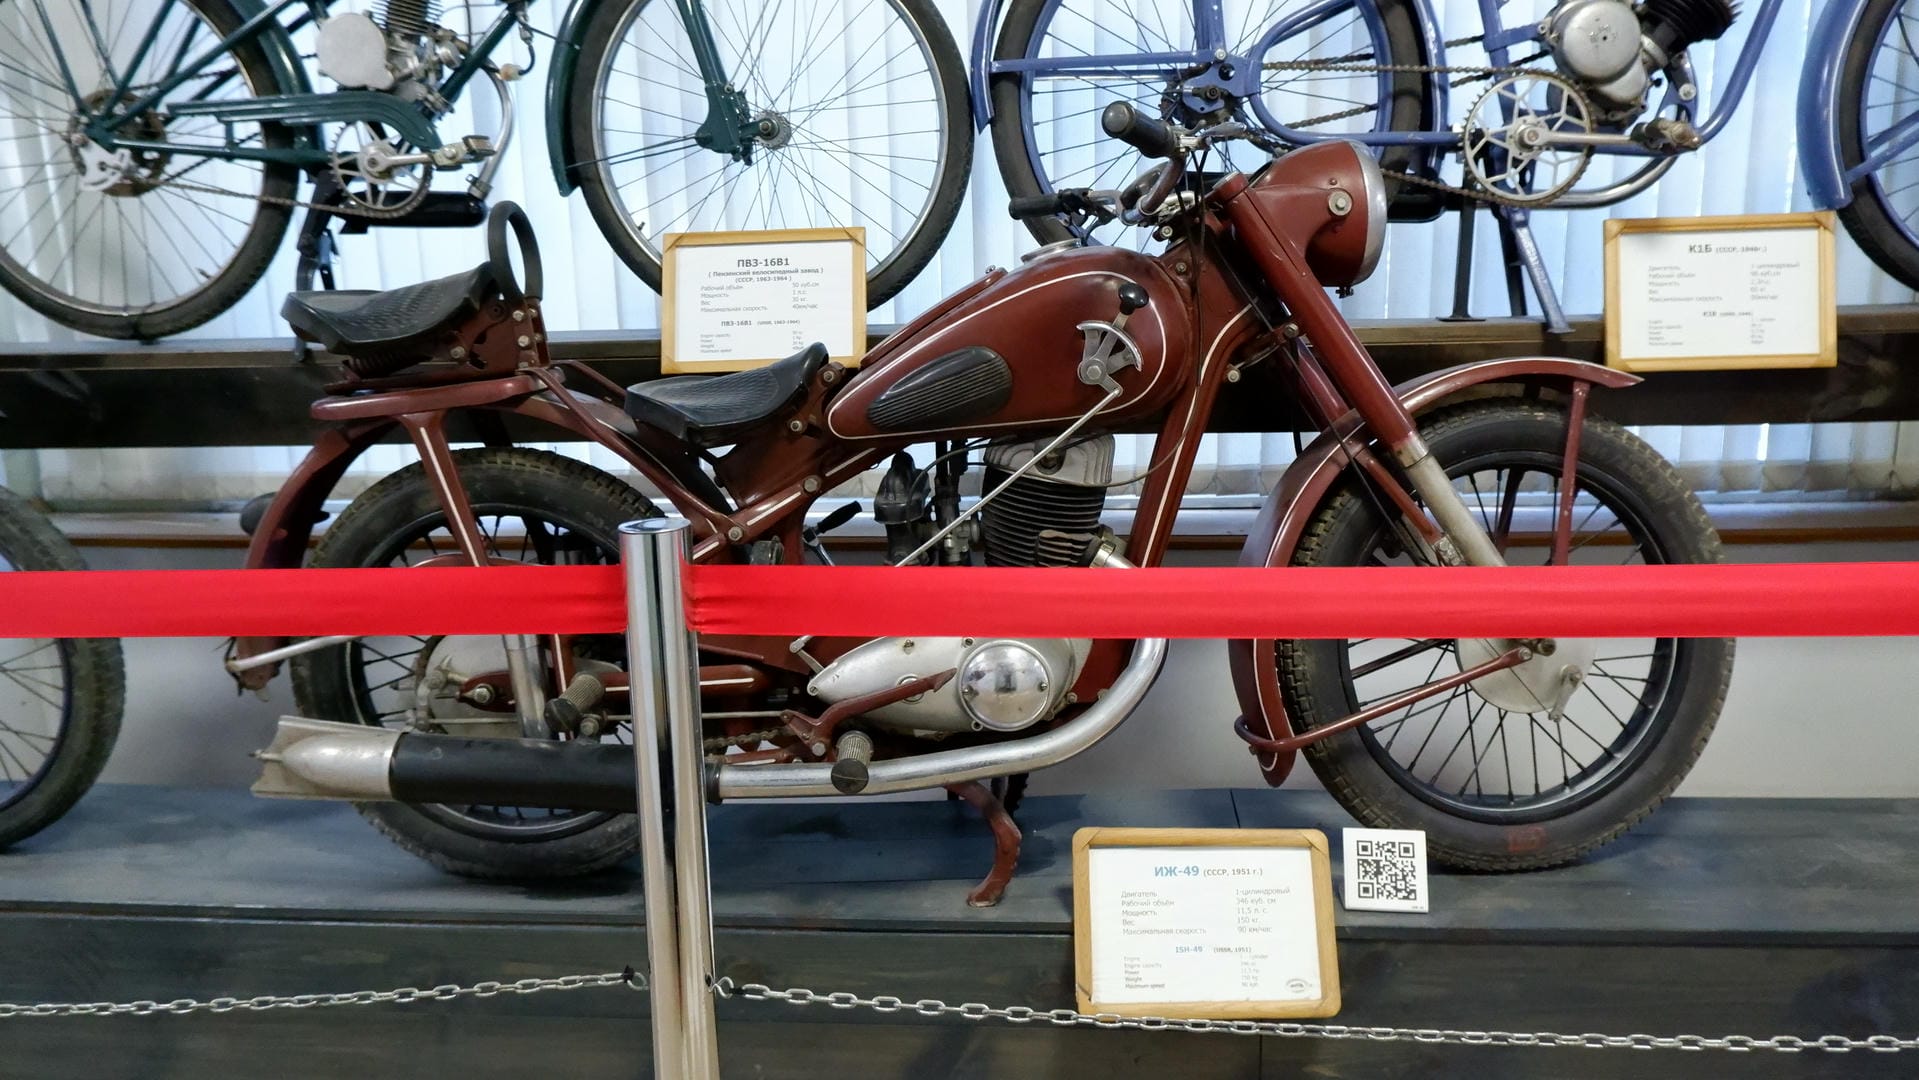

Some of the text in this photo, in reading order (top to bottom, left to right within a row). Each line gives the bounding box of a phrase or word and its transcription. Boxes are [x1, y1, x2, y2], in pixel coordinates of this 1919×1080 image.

[1154, 865, 1200, 877] ИЖ-49
[1203, 868, 1230, 877] (СССР,
[1232, 868, 1250, 876] 1951
[1120, 891, 1158, 899] Двигатель
[1123, 928, 1207, 936] Максимальная скорость
